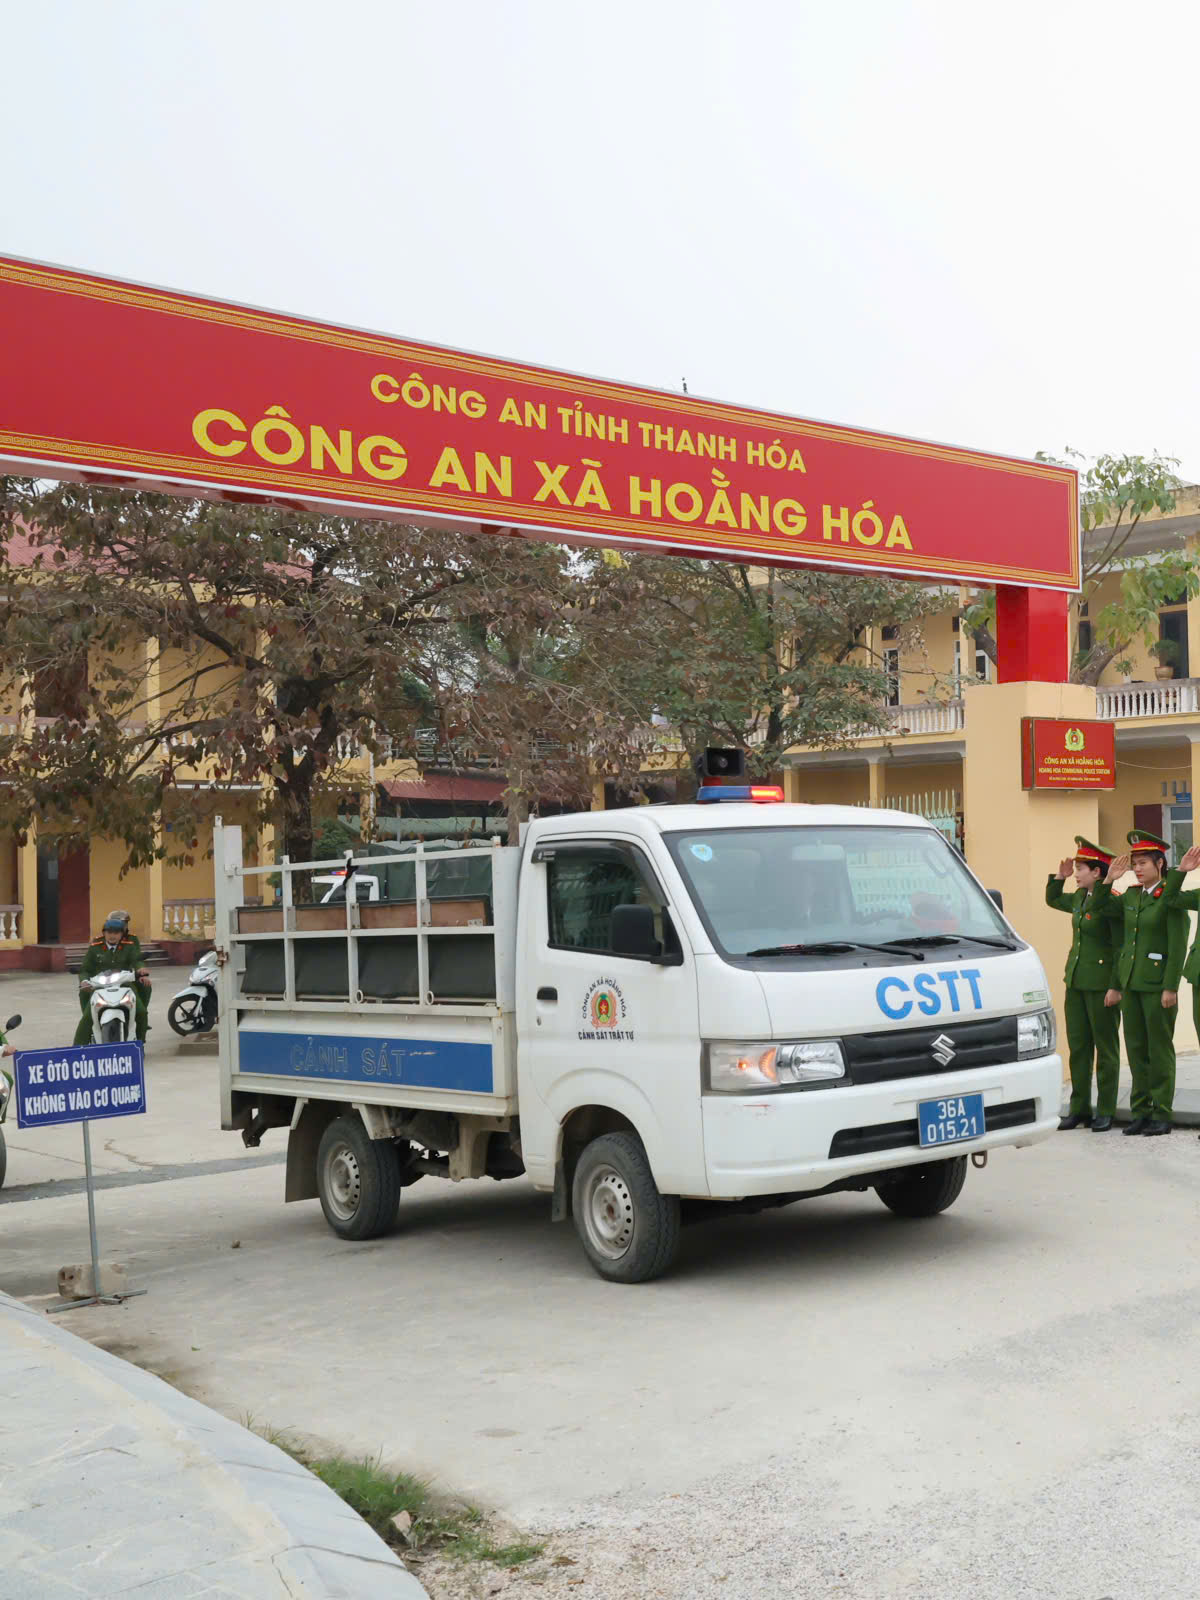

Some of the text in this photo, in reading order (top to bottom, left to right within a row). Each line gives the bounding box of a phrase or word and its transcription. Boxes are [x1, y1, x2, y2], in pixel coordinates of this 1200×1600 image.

[371, 372, 807, 473] CÔNG AN TỈNH THANH HÓA
[192, 405, 913, 550] CÔNG AN XÃ HOẰNG HÓA
[1045, 756, 1059, 765] CÔNG
[1060, 757, 1067, 765] AN
[875, 968, 983, 1020] CSTT
[578, 1029, 634, 1042] CẢNH SÁT TRẬT TỰ
[28, 1053, 133, 1085] XE ÔTÔ CỦA KHÁCH
[290, 1037, 406, 1077] CẢNH SÁT
[24, 1091, 66, 1116] KHÔNG
[68, 1087, 91, 1111] VÀO
[93, 1088, 109, 1108] CƠ
[938, 1099, 966, 1119] 36A
[927, 1117, 977, 1143] 015.21
